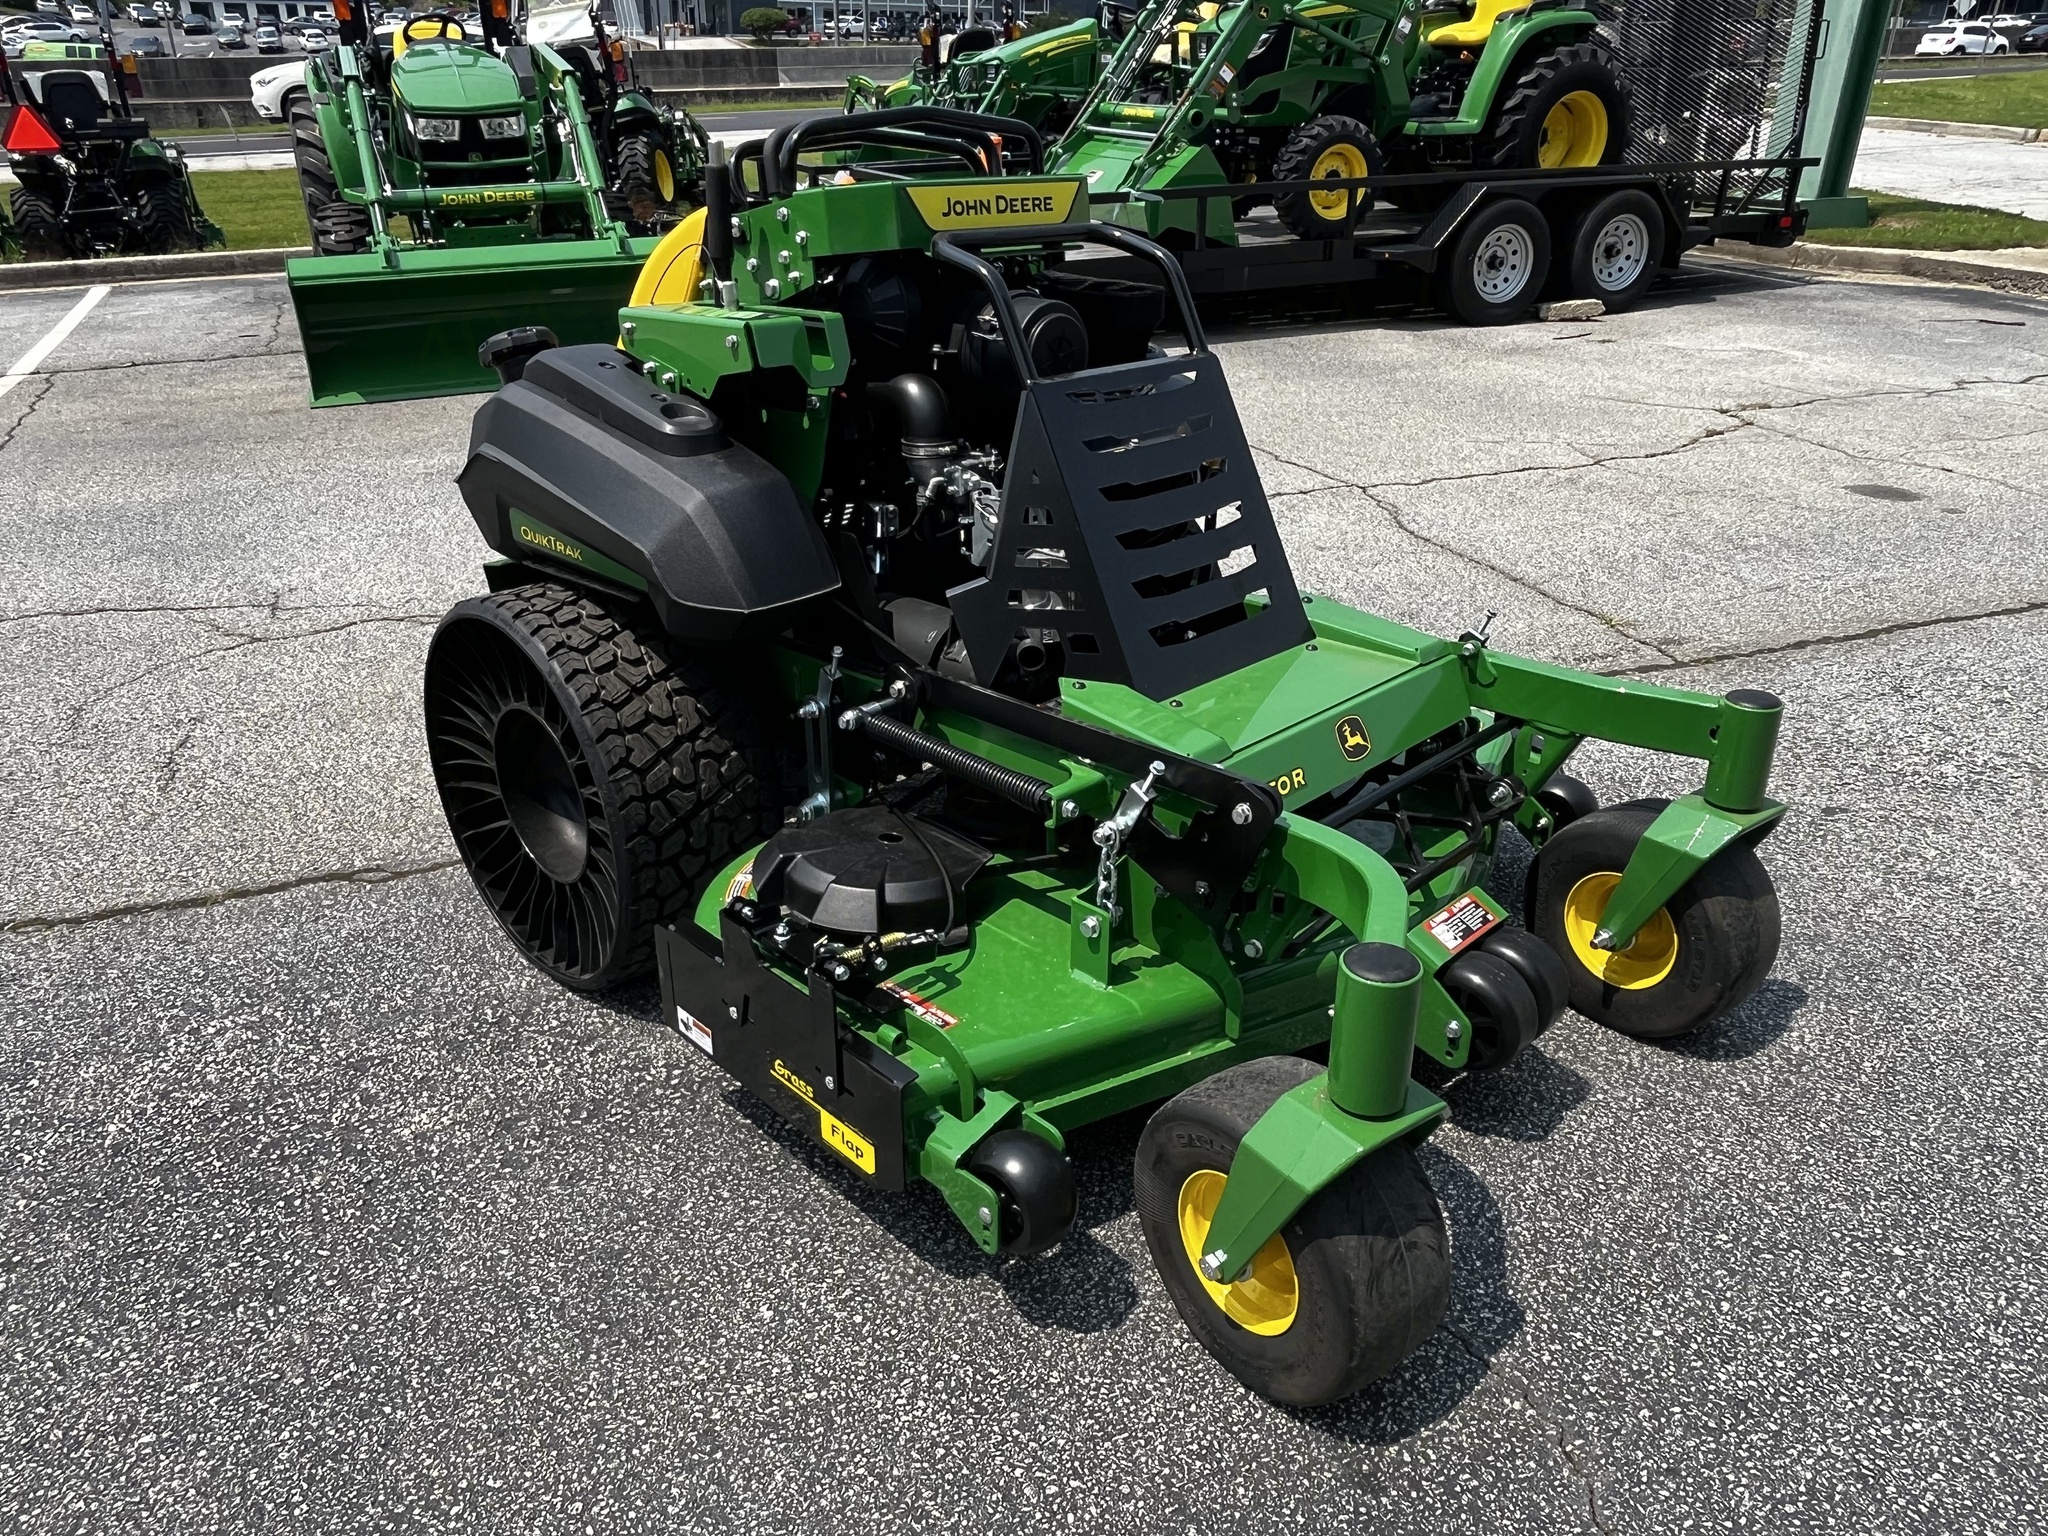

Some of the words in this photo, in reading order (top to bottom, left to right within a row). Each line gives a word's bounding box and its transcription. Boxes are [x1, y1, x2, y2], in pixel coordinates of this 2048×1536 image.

[439, 193, 481, 206] JOHN
[482, 190, 535, 203] DEERE
[941, 196, 992, 218] JOHN
[995, 194, 1054, 215] DEERE
[773, 1058, 815, 1099] Grass
[830, 1123, 865, 1160] Flap
